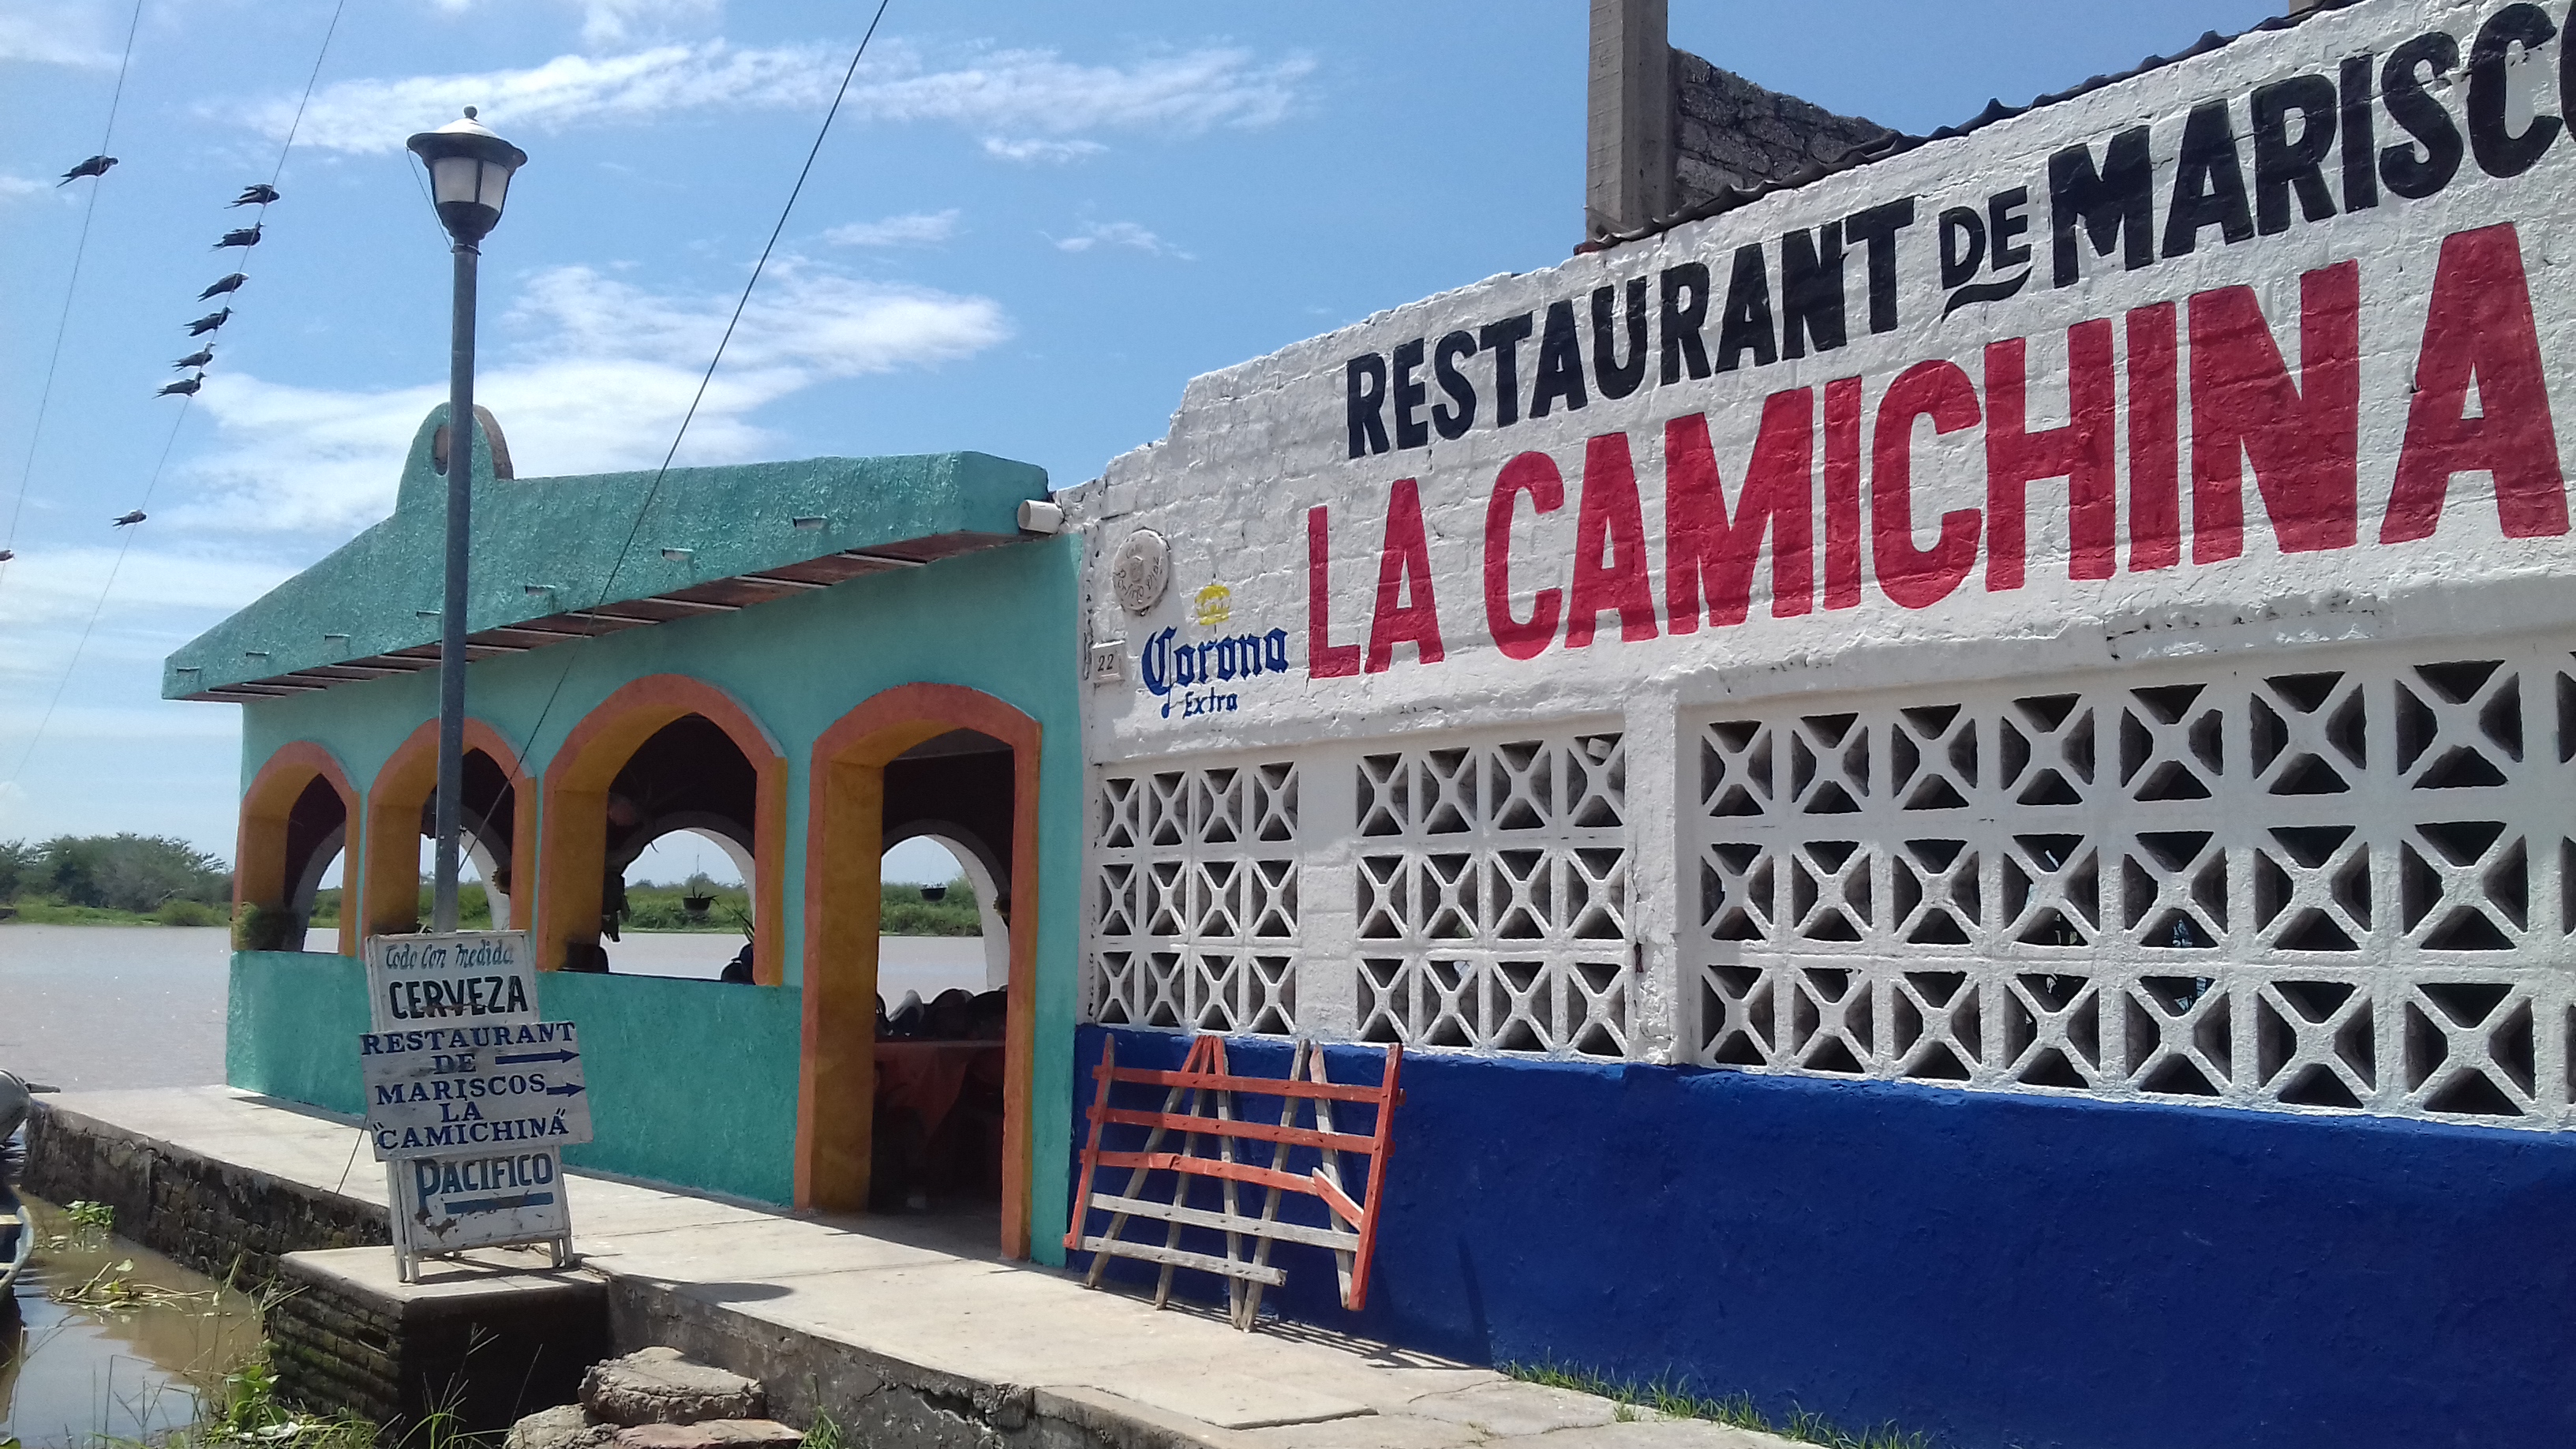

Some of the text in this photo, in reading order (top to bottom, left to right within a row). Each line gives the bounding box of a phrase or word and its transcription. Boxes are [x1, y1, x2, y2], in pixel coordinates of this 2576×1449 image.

[1346, 0, 2576, 459] RESTAURANT DE MARISC
[1308, 222, 2570, 679] LA CAMICHINA
[1097, 653, 1114, 671] 22
[1141, 626, 1290, 719] Corona
[1182, 687, 1238, 719] Extra
[389, 975, 528, 1020] CERVEZA
[361, 1021, 575, 1055] RESTAURANT
[431, 1053, 477, 1075] DE
[375, 1074, 545, 1105] MARISCOS
[439, 1101, 484, 1122] LA
[414, 1152, 553, 1219] PACIFICO
